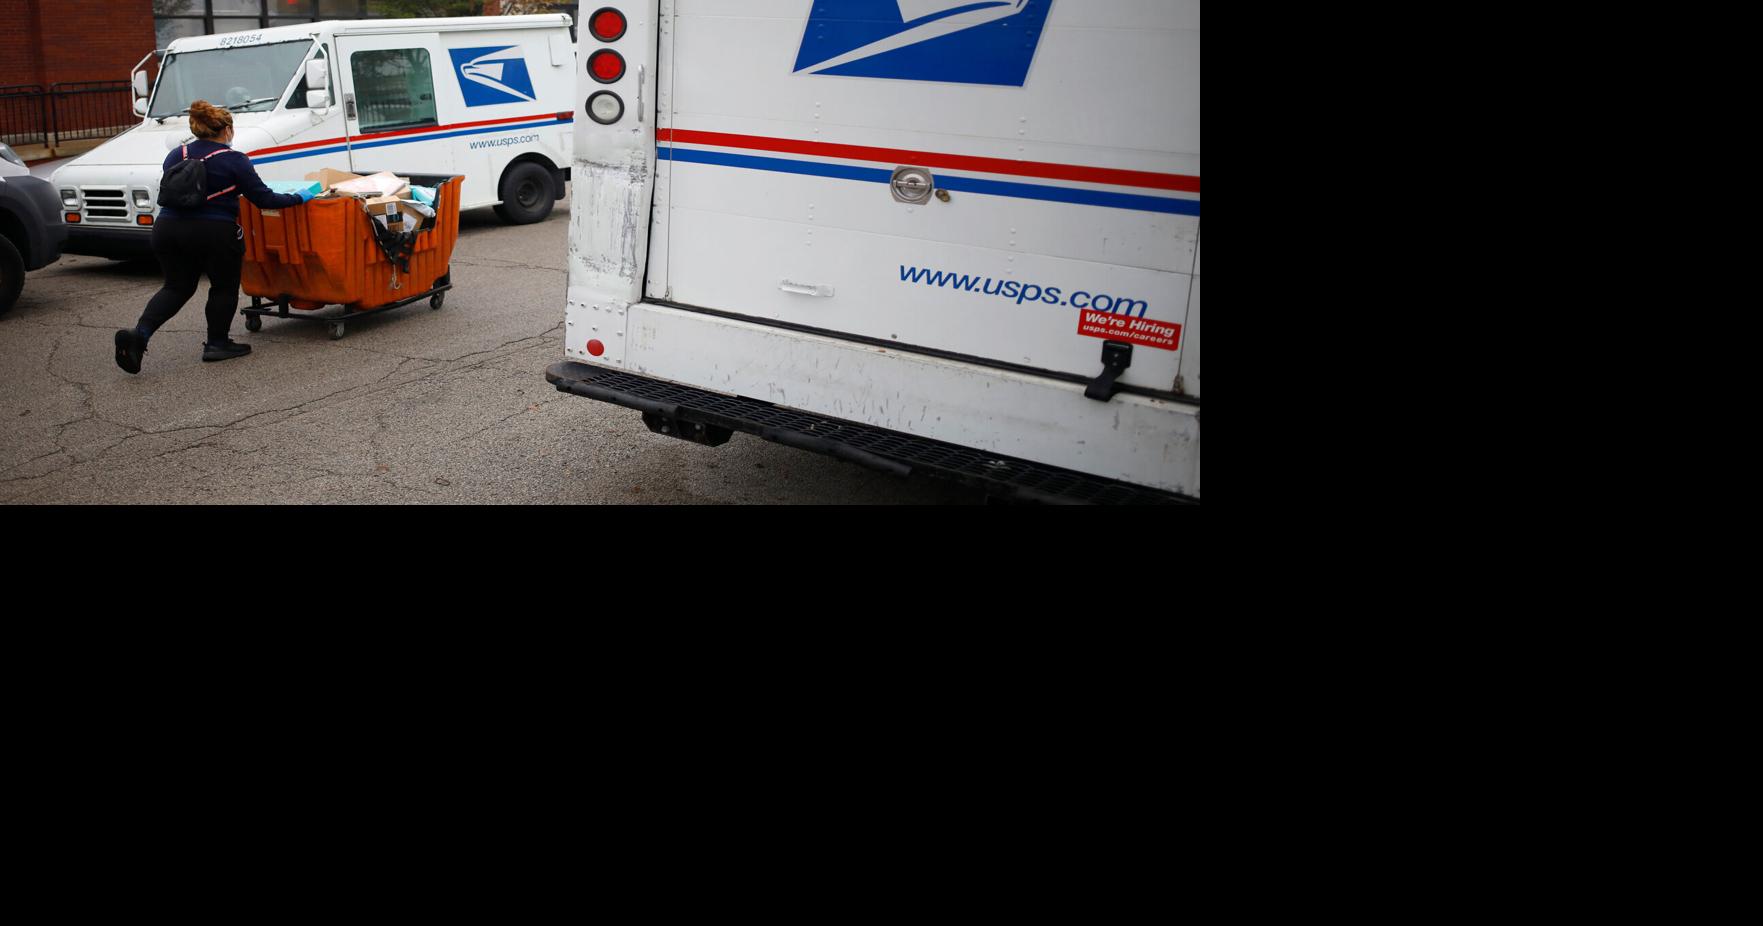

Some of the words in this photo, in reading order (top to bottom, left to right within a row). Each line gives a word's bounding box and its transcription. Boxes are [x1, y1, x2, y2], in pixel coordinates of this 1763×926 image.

[220, 34, 263, 46] 8218054
[470, 134, 539, 149] www.usps.com
[900, 264, 1148, 318] www.usps.com
[1083, 324, 1173, 345] usps.com/careers
[1085, 312, 1126, 327] We're
[1129, 319, 1175, 337] Hiring
